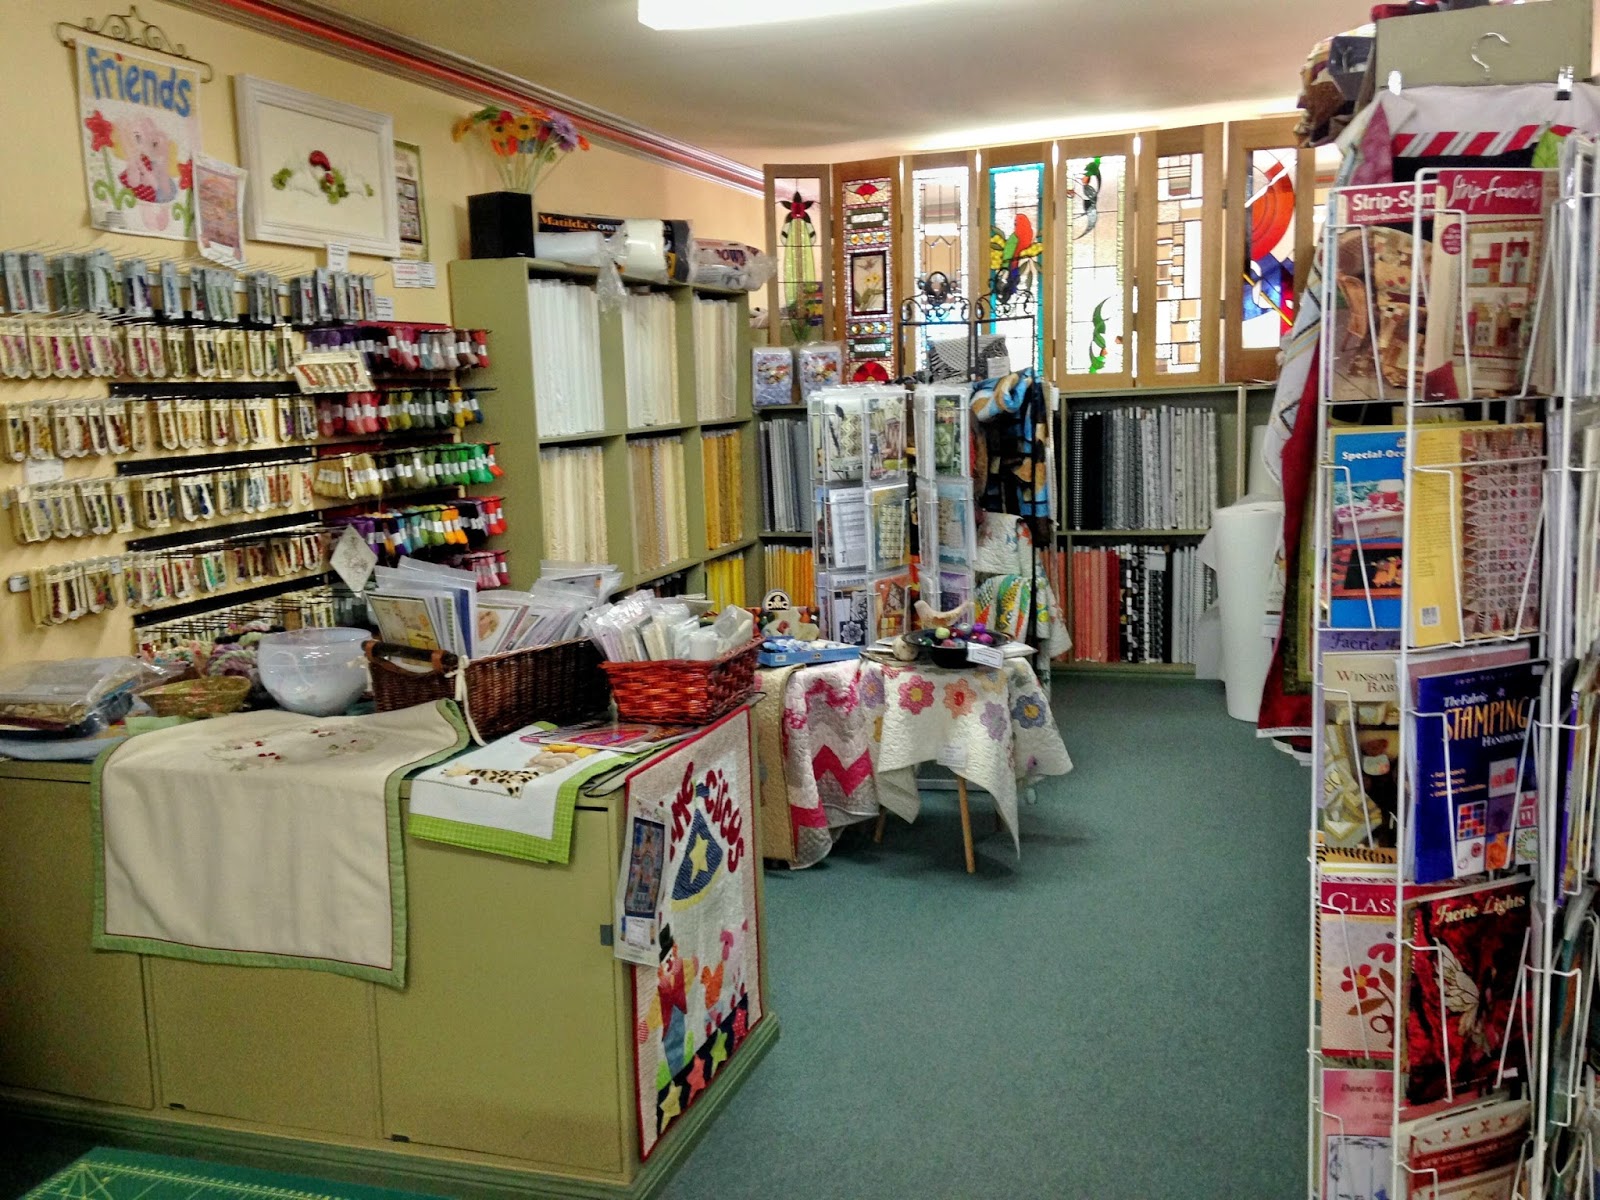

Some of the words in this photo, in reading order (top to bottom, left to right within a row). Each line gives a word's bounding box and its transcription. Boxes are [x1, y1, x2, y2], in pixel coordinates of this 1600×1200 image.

[86, 47, 192, 118] friends
[540, 214, 597, 230] Matilda's
[1330, 632, 1379, 651] Faerie
[1444, 696, 1529, 741] STAMPING
[1434, 904, 1479, 926] Faerie
[1481, 894, 1526, 916] Lights
